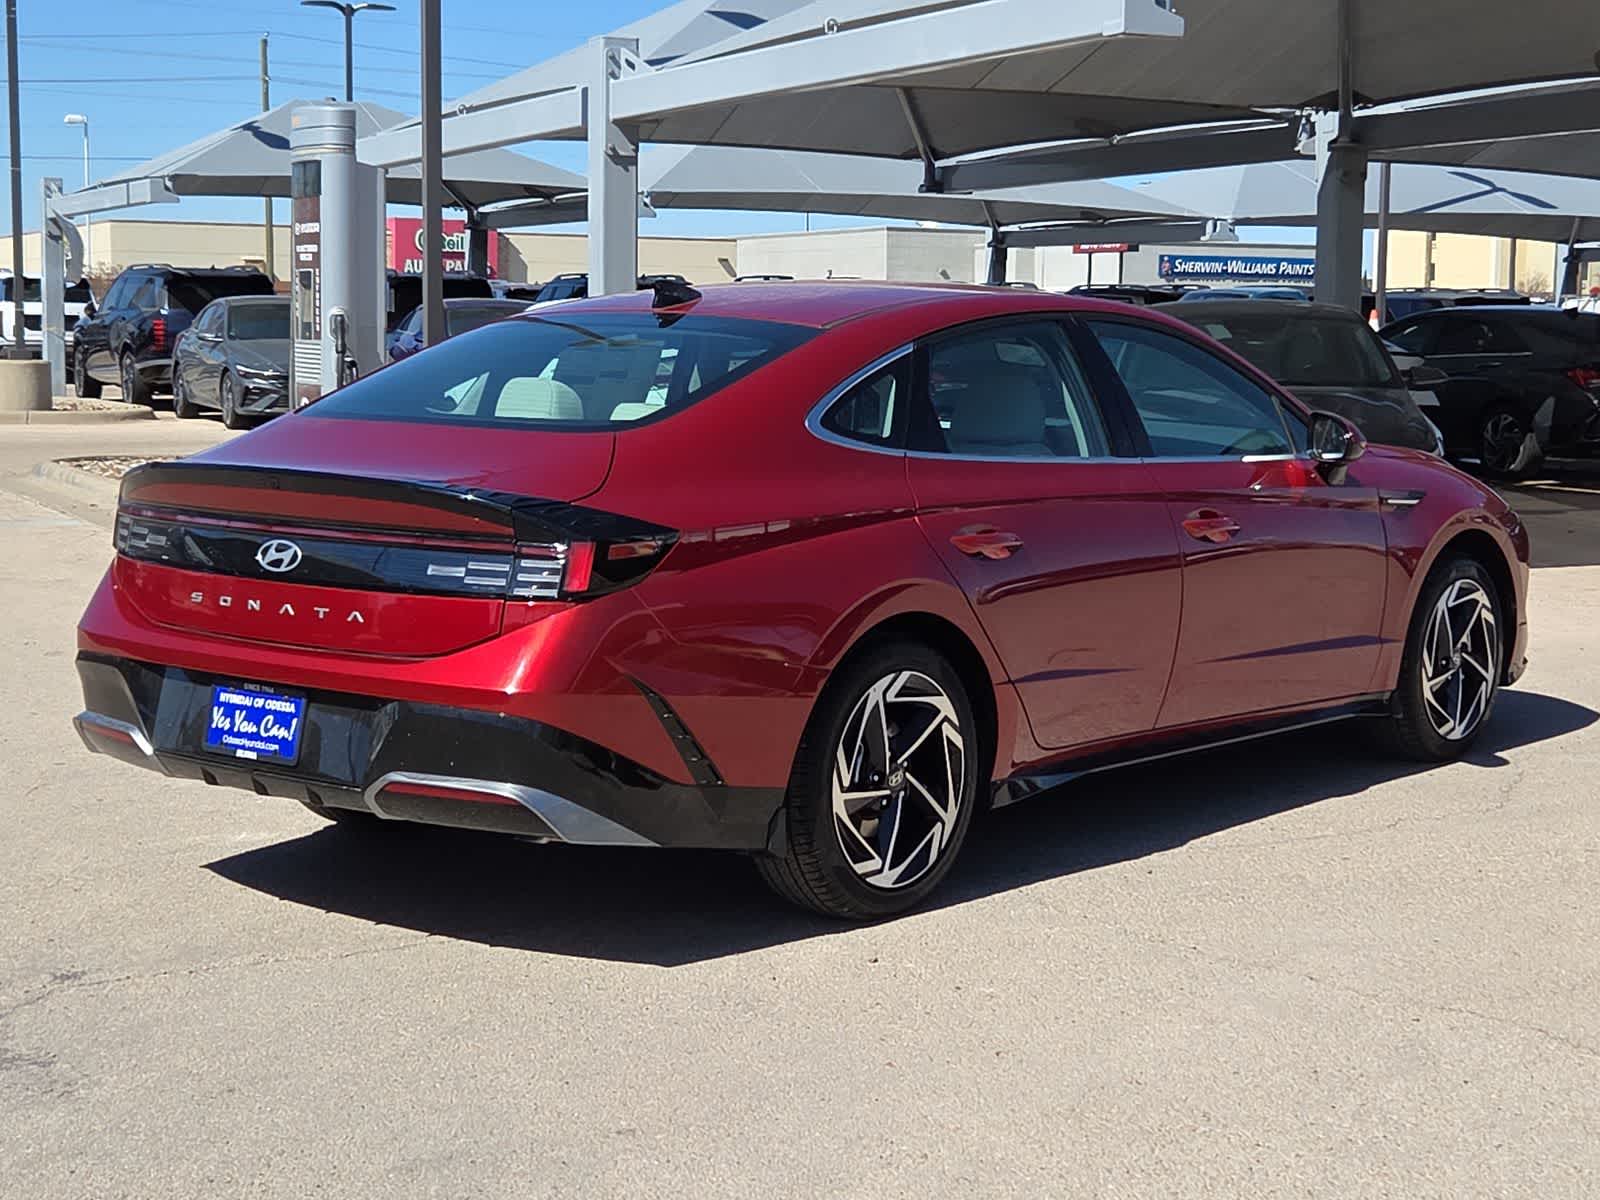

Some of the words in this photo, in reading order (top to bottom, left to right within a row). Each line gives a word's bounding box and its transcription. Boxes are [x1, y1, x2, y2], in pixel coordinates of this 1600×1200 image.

[1174, 259, 1276, 275] SHERWIN-WILLIAMS
[1279, 262, 1315, 276] PAINTS
[190, 592, 364, 623] SONATA
[219, 692, 253, 707] HYUNDAI
[253, 698, 266, 708] OF
[265, 700, 296, 714] ODESSA
[211, 706, 231, 731] Yes
[233, 710, 258, 733] You
[260, 715, 298, 741] Can!
